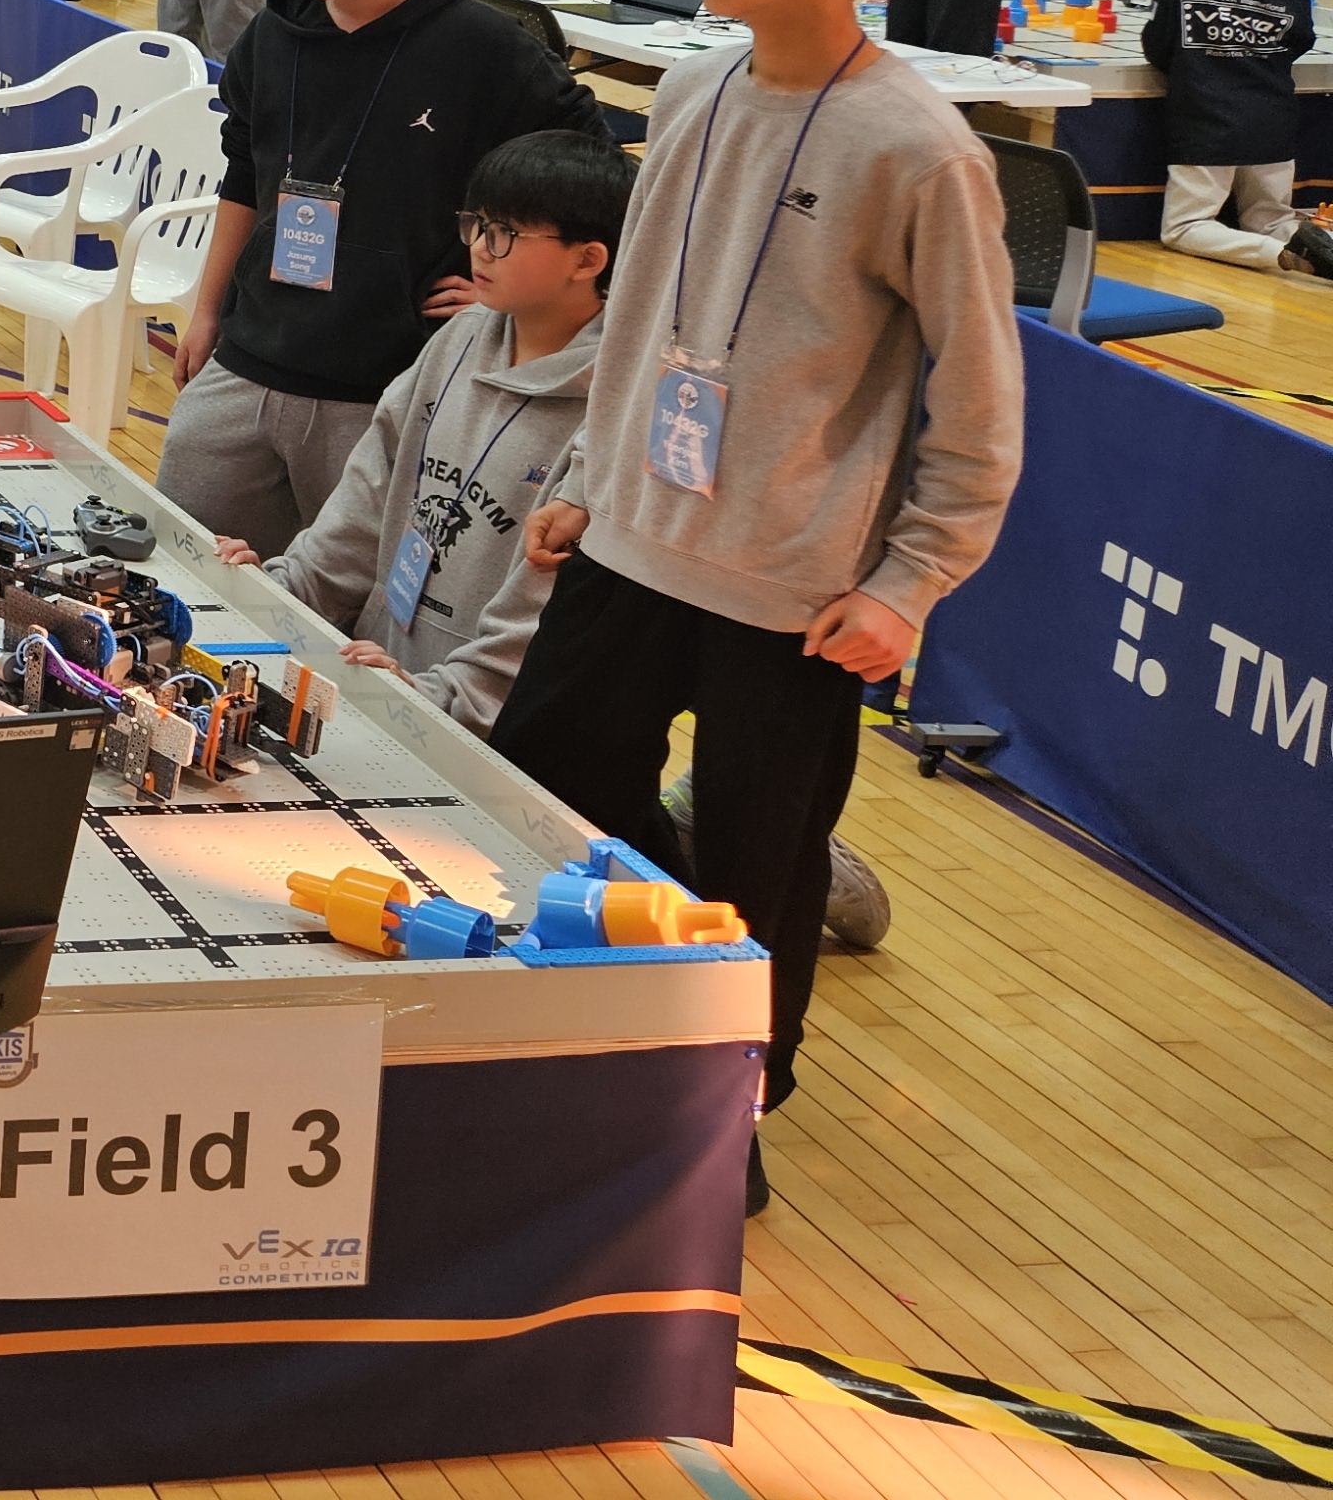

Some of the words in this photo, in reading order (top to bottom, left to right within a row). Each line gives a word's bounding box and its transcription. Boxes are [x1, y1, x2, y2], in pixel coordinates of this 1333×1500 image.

[1195, 7, 1252, 29] VEX
[283, 227, 325, 245] 10432G
[287, 250, 317, 265] Jusung
[289, 261, 311, 274] Song
[90, 465, 118, 496] VEX
[467, 480, 519, 536] GYM
[174, 530, 206, 568] VEX
[270, 607, 308, 651] VEX
[1209, 623, 1333, 767] TM
[6, 728, 45, 739] Robotics
[386, 700, 428, 749] VEX
[522, 807, 574, 860] VEX
[0, 1111, 251, 1199] Field
[288, 1108, 342, 1188] 3
[222, 1230, 314, 1261] VEX
[320, 1238, 362, 1257] IQ
[218, 1271, 360, 1286] COMPETITION
[219, 1259, 361, 1273] ROBOTICS
